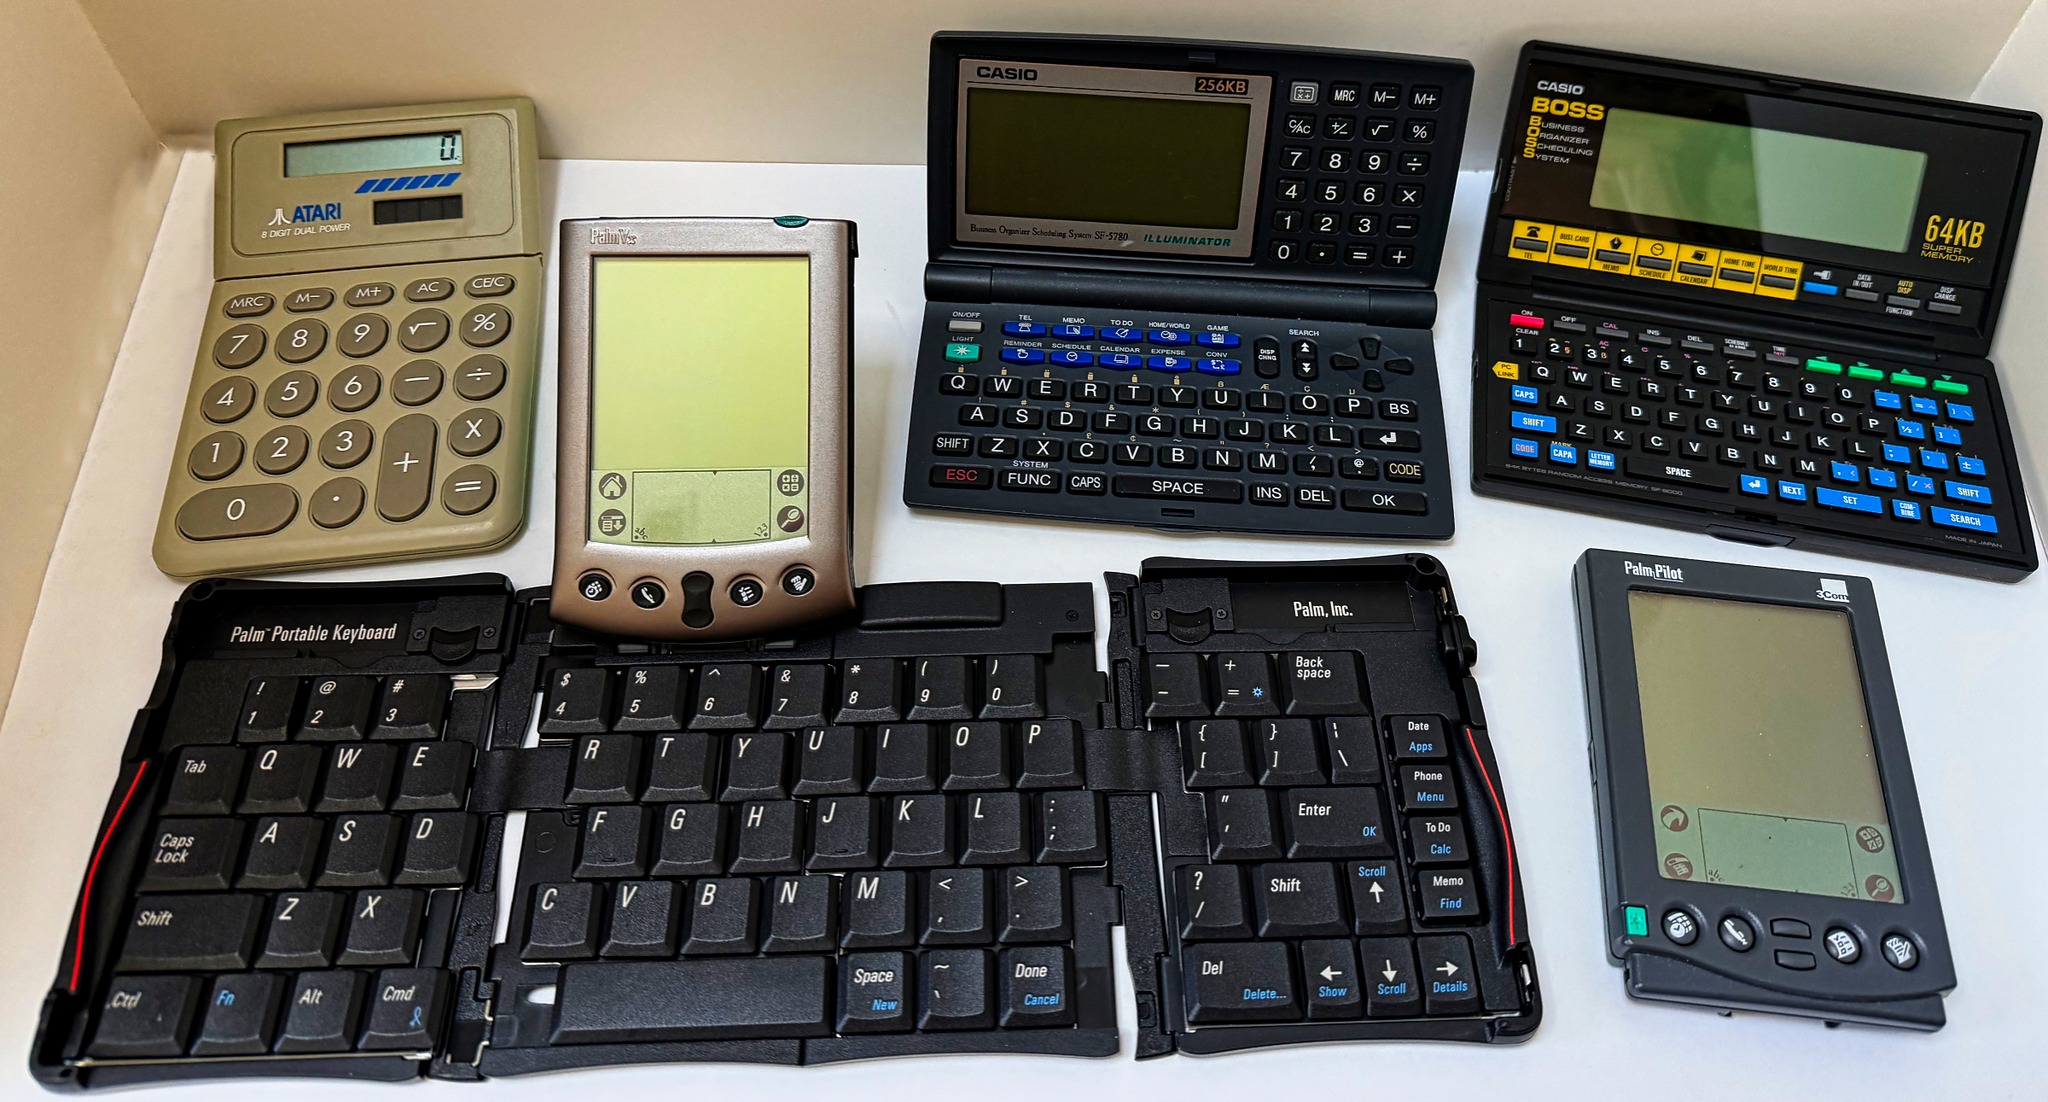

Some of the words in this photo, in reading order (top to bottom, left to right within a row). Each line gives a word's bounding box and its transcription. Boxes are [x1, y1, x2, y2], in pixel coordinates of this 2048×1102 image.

[976, 66, 1038, 81] CASIO
[1197, 79, 1246, 93] 256KB
[1537, 80, 1584, 95] CASIO
[1334, 90, 1355, 102] MRC
[1414, 93, 1436, 105] M+
[1531, 96, 1605, 121] BOSS
[1529, 115, 1584, 133] BUSINESS
[1527, 126, 1589, 145] ORGANIZER
[1525, 137, 1593, 156] SCHEDULING
[1523, 147, 1570, 164] SYSTEM
[292, 202, 342, 223] ATARI
[261, 231, 268, 239] 8
[269, 228, 291, 238] DIGIT
[294, 226, 317, 236] DUAL
[319, 223, 351, 234] POWER
[999, 225, 1031, 238] Organizer
[1031, 227, 1067, 239] Scheduling
[1068, 229, 1092, 241] System
[1094, 230, 1129, 242] SF-5780
[1925, 214, 1986, 249] 64KB
[1143, 233, 1232, 247] ILLUMINATOR
[1576, 235, 1589, 243] CARD
[1922, 243, 1962, 255] SUPER
[1724, 257, 1740, 266] HOME
[1741, 260, 1755, 268] TIME
[1920, 250, 1974, 264] MEMORY
[1602, 264, 1620, 272] MEMO
[1639, 269, 1666, 279] SCHEDULE
[1764, 263, 1783, 273] WORLD
[1784, 266, 1798, 274] TIME
[1680, 275, 1708, 285] CALENDAR
[356, 286, 382, 298] M+
[417, 281, 440, 293] AC
[1940, 286, 1954, 294] DISP
[230, 295, 265, 308] MRC
[1934, 293, 1956, 301] CHANGE
[1886, 306, 1913, 316] FUNCTION
[1149, 321, 1190, 330] HOME/WORLD
[1603, 322, 1619, 330] CAL
[292, 329, 308, 348] 8
[354, 323, 370, 343] 9
[1289, 329, 1319, 337] SEARCH
[229, 334, 249, 354] 7
[1003, 340, 1043, 348] REMINDER
[1051, 343, 1092, 351] SCHEDULE
[1151, 348, 1186, 356] EXPENSE
[1498, 370, 1514, 378] LINK
[1515, 390, 1534, 399] CAPS
[1389, 403, 1410, 415] BS
[1523, 418, 1545, 427] SHIFT
[936, 437, 969, 449] SHIFT
[1515, 443, 1534, 453] CODE
[1553, 449, 1573, 459] CAPA
[1013, 460, 1048, 468] SYSTEM
[1389, 463, 1420, 476] CODE
[946, 469, 978, 481] ESC
[1666, 466, 1691, 477] SPACE
[1008, 472, 1051, 486] FUNC
[1071, 475, 1101, 488] CAPS
[1615, 479, 1648, 490] MEMORY
[1152, 480, 1204, 495] SPACE
[1256, 486, 1282, 499] INS
[1783, 485, 1801, 496] NEXT
[1957, 487, 1980, 498] SHIFT
[1301, 489, 1330, 502] DEL
[1372, 494, 1396, 507] OK
[1843, 496, 1857, 505] SET
[227, 498, 246, 520] 0
[1950, 513, 1981, 526] SEARCH
[634, 527, 649, 540] abc
[1978, 540, 2003, 549] JAPAN
[1816, 588, 1848, 602] 3Com
[1293, 602, 1329, 618] Palm,
[1330, 602, 1353, 616] Inc.
[271, 625, 328, 642] Portable
[332, 624, 397, 644] Keyboard
[1296, 656, 1323, 668] Back
[1297, 668, 1331, 680] space
[1408, 721, 1429, 732] Date
[1409, 741, 1433, 753] Apps
[184, 759, 206, 774] Tab
[1414, 771, 1443, 782] Phone
[1417, 792, 1444, 802] Menu
[1298, 803, 1331, 817] Enter
[1363, 826, 1376, 837] OK
[1425, 823, 1436, 833] To
[1438, 823, 1451, 833] Do
[160, 833, 194, 850] Caps
[1430, 843, 1451, 855] Calc
[155, 850, 189, 864] Lock
[1358, 866, 1386, 878] Scroll
[1270, 878, 1301, 893] Shift
[1433, 876, 1463, 887] Memo
[1440, 897, 1462, 909] Find
[138, 910, 174, 926] Shift
[1015, 964, 1047, 978] Done
[1202, 961, 1223, 976] Del
[854, 969, 894, 986] Space
[1318, 986, 1347, 998] Show
[1378, 983, 1406, 995] Scroll
[1433, 981, 1468, 993] Details
[217, 991, 234, 1006] Fn
[299, 990, 322, 1004] Alt
[383, 986, 415, 1001] Cmd
[1024, 993, 1059, 1006] Cancel
[1243, 988, 1287, 1000] Delete...
[111, 992, 142, 1008] Ctrl
[872, 999, 897, 1011] New
